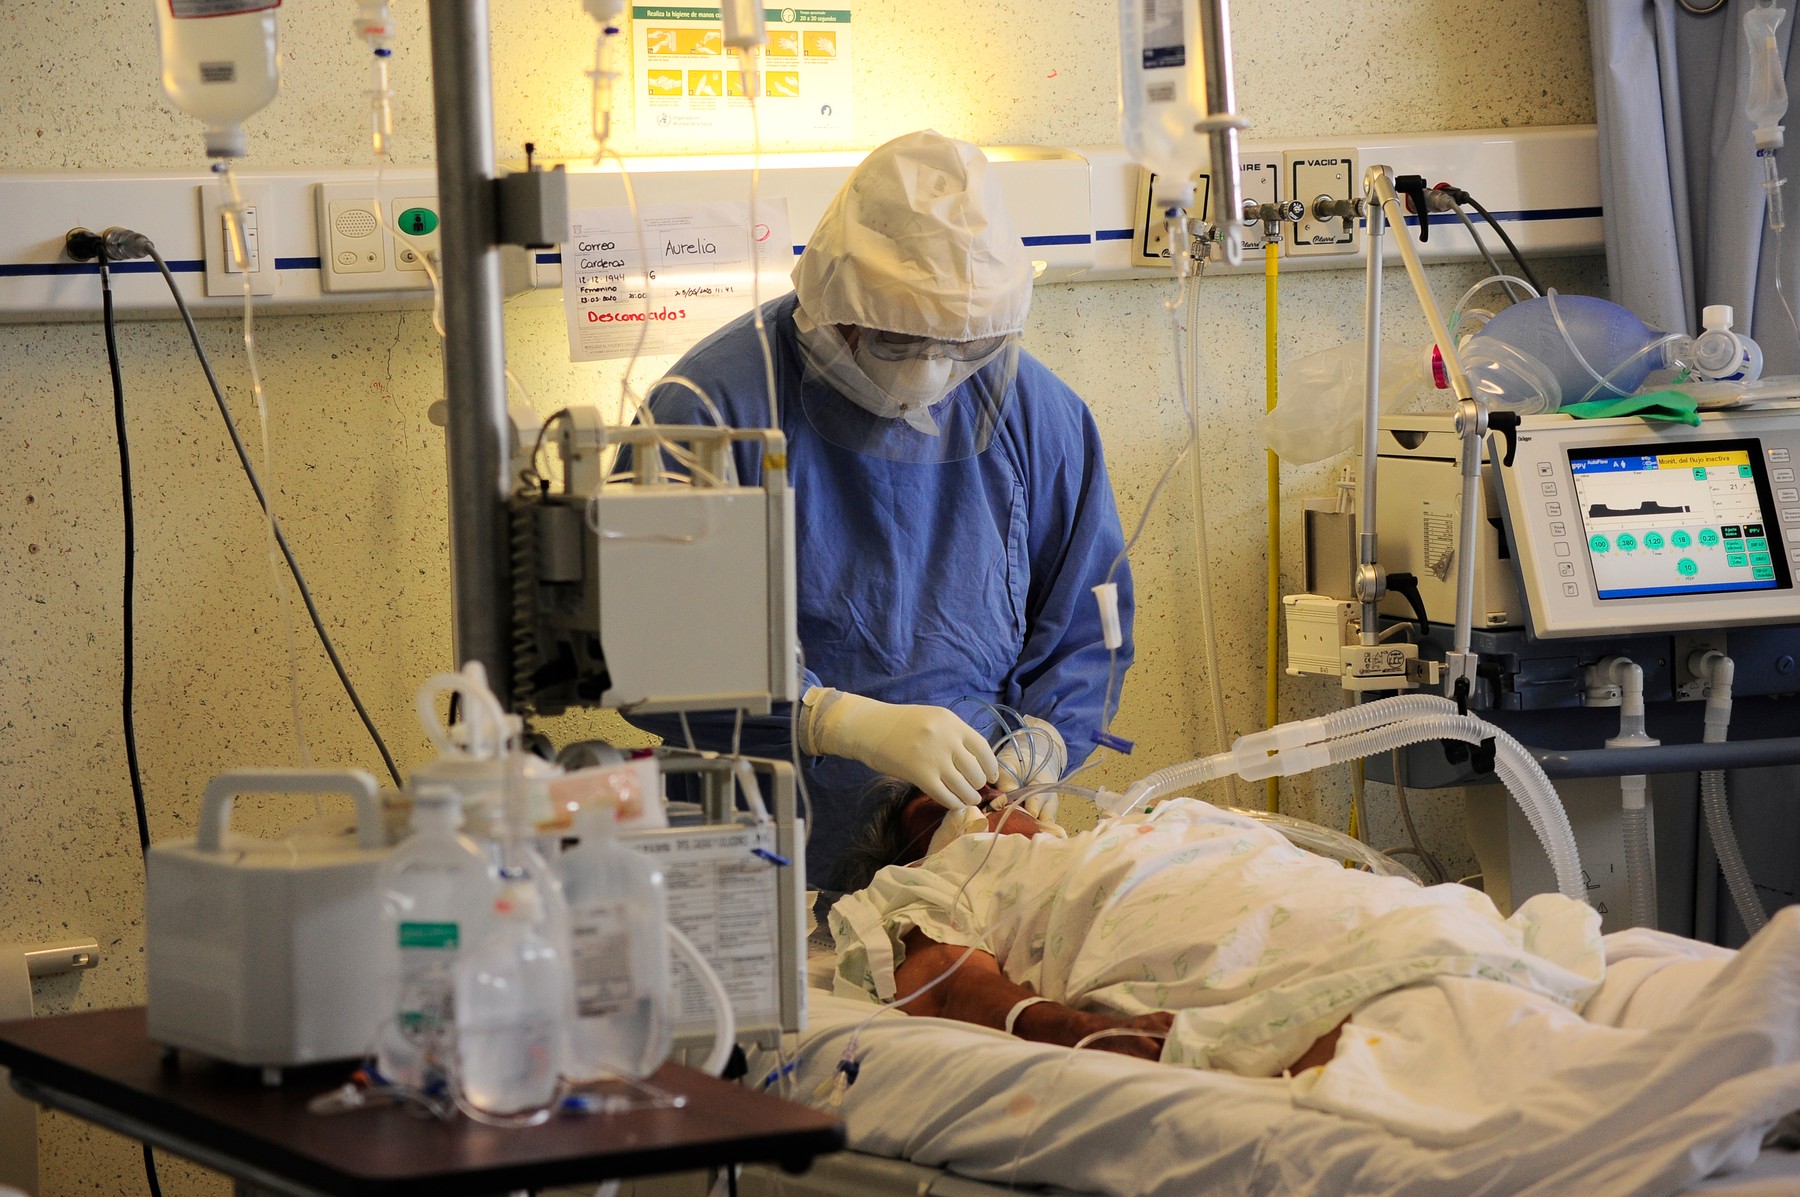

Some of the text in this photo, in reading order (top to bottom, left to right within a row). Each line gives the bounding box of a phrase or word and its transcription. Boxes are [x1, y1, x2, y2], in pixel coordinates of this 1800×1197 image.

[671, 11, 690, 19] higiene
[578, 241, 615, 252] Correa
[665, 238, 717, 256] Aurelia
[580, 258, 625, 269] Cardenas
